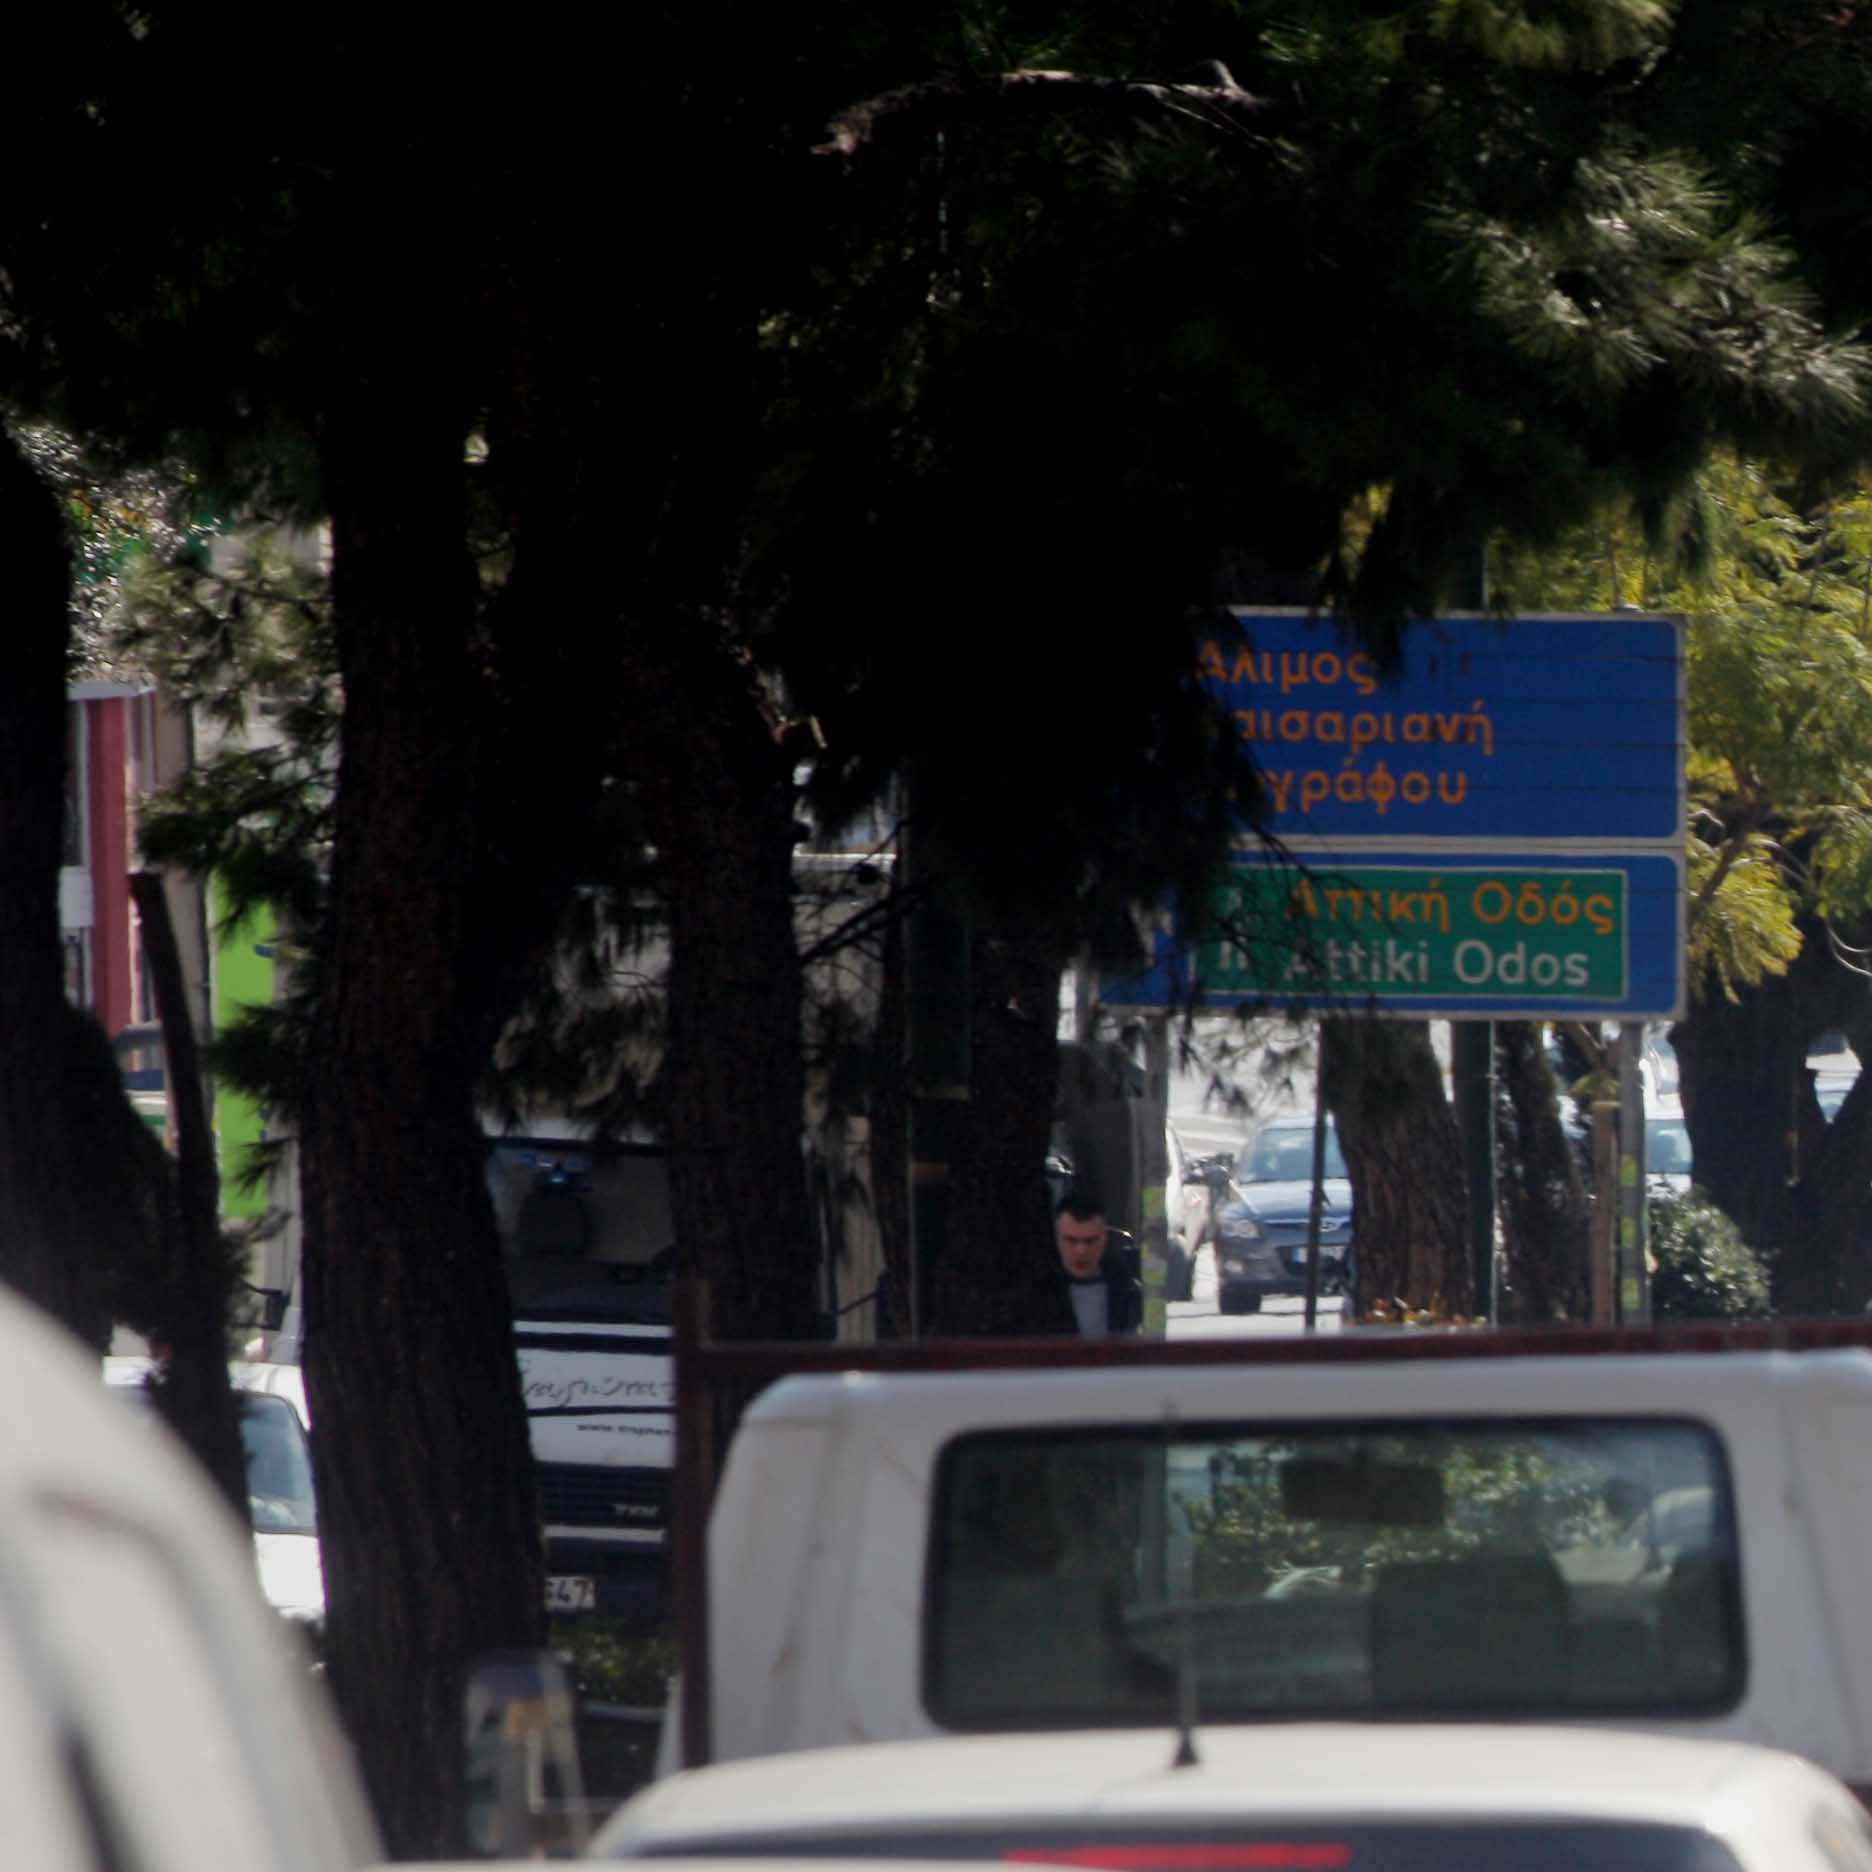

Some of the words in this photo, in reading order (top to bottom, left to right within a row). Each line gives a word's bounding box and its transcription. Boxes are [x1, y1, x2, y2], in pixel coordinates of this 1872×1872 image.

[1233, 698, 1495, 755] αισαριανή
[1266, 757, 1468, 815] γράφου
[1472, 880, 1616, 935] Οδός
[1454, 938, 1590, 986] Odos
